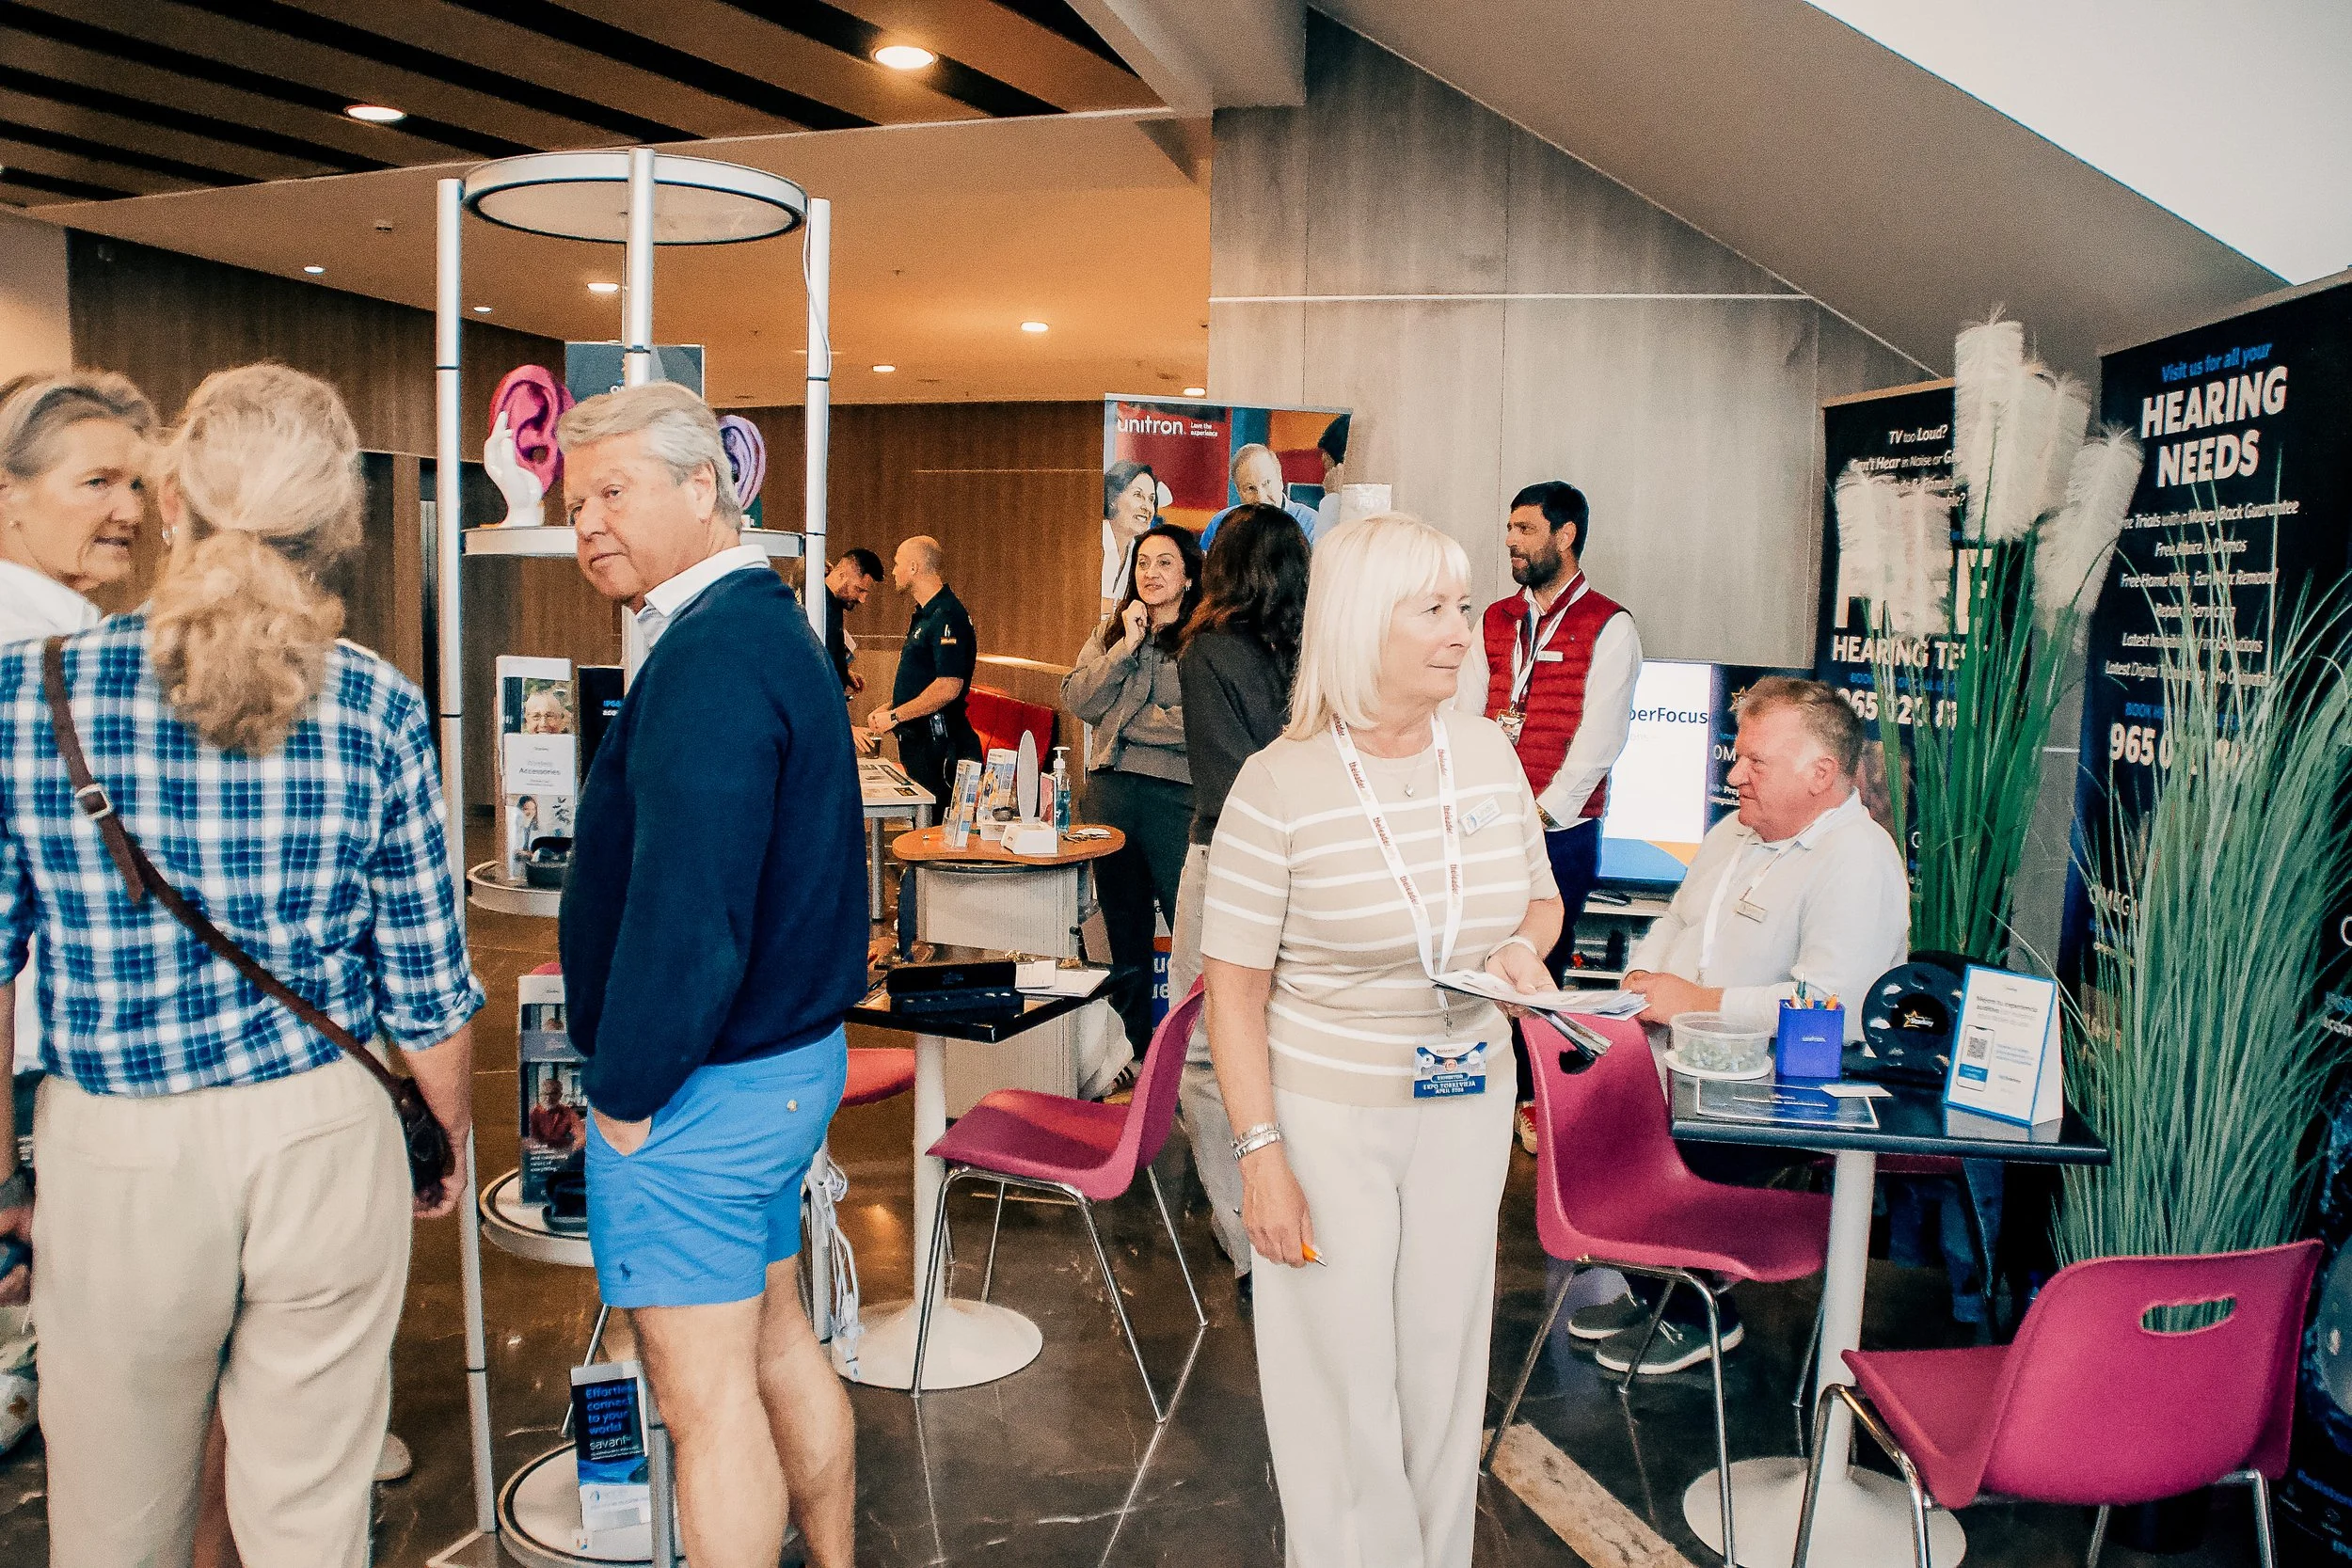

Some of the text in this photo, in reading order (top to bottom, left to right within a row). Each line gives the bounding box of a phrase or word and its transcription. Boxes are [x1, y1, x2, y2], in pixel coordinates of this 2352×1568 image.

[2162, 342, 2273, 383] Visit us for all your
[2140, 365, 2289, 439] HEARING
[1117, 415, 1184, 436] unitron
[1889, 429, 1904, 445] TV
[1916, 424, 1948, 442] Loud?
[1877, 456, 1900, 469] Hear
[2156, 429, 2261, 487] NEEDS
[2135, 512, 2161, 529] Trials
[2122, 632, 2150, 647] Latest
[1833, 636, 1930, 668] HEARING
[2106, 659, 2131, 676] Latest
[2110, 722, 2156, 767] 965
[588, 1410, 628, 1424] to your
[588, 1422, 622, 1435] world
